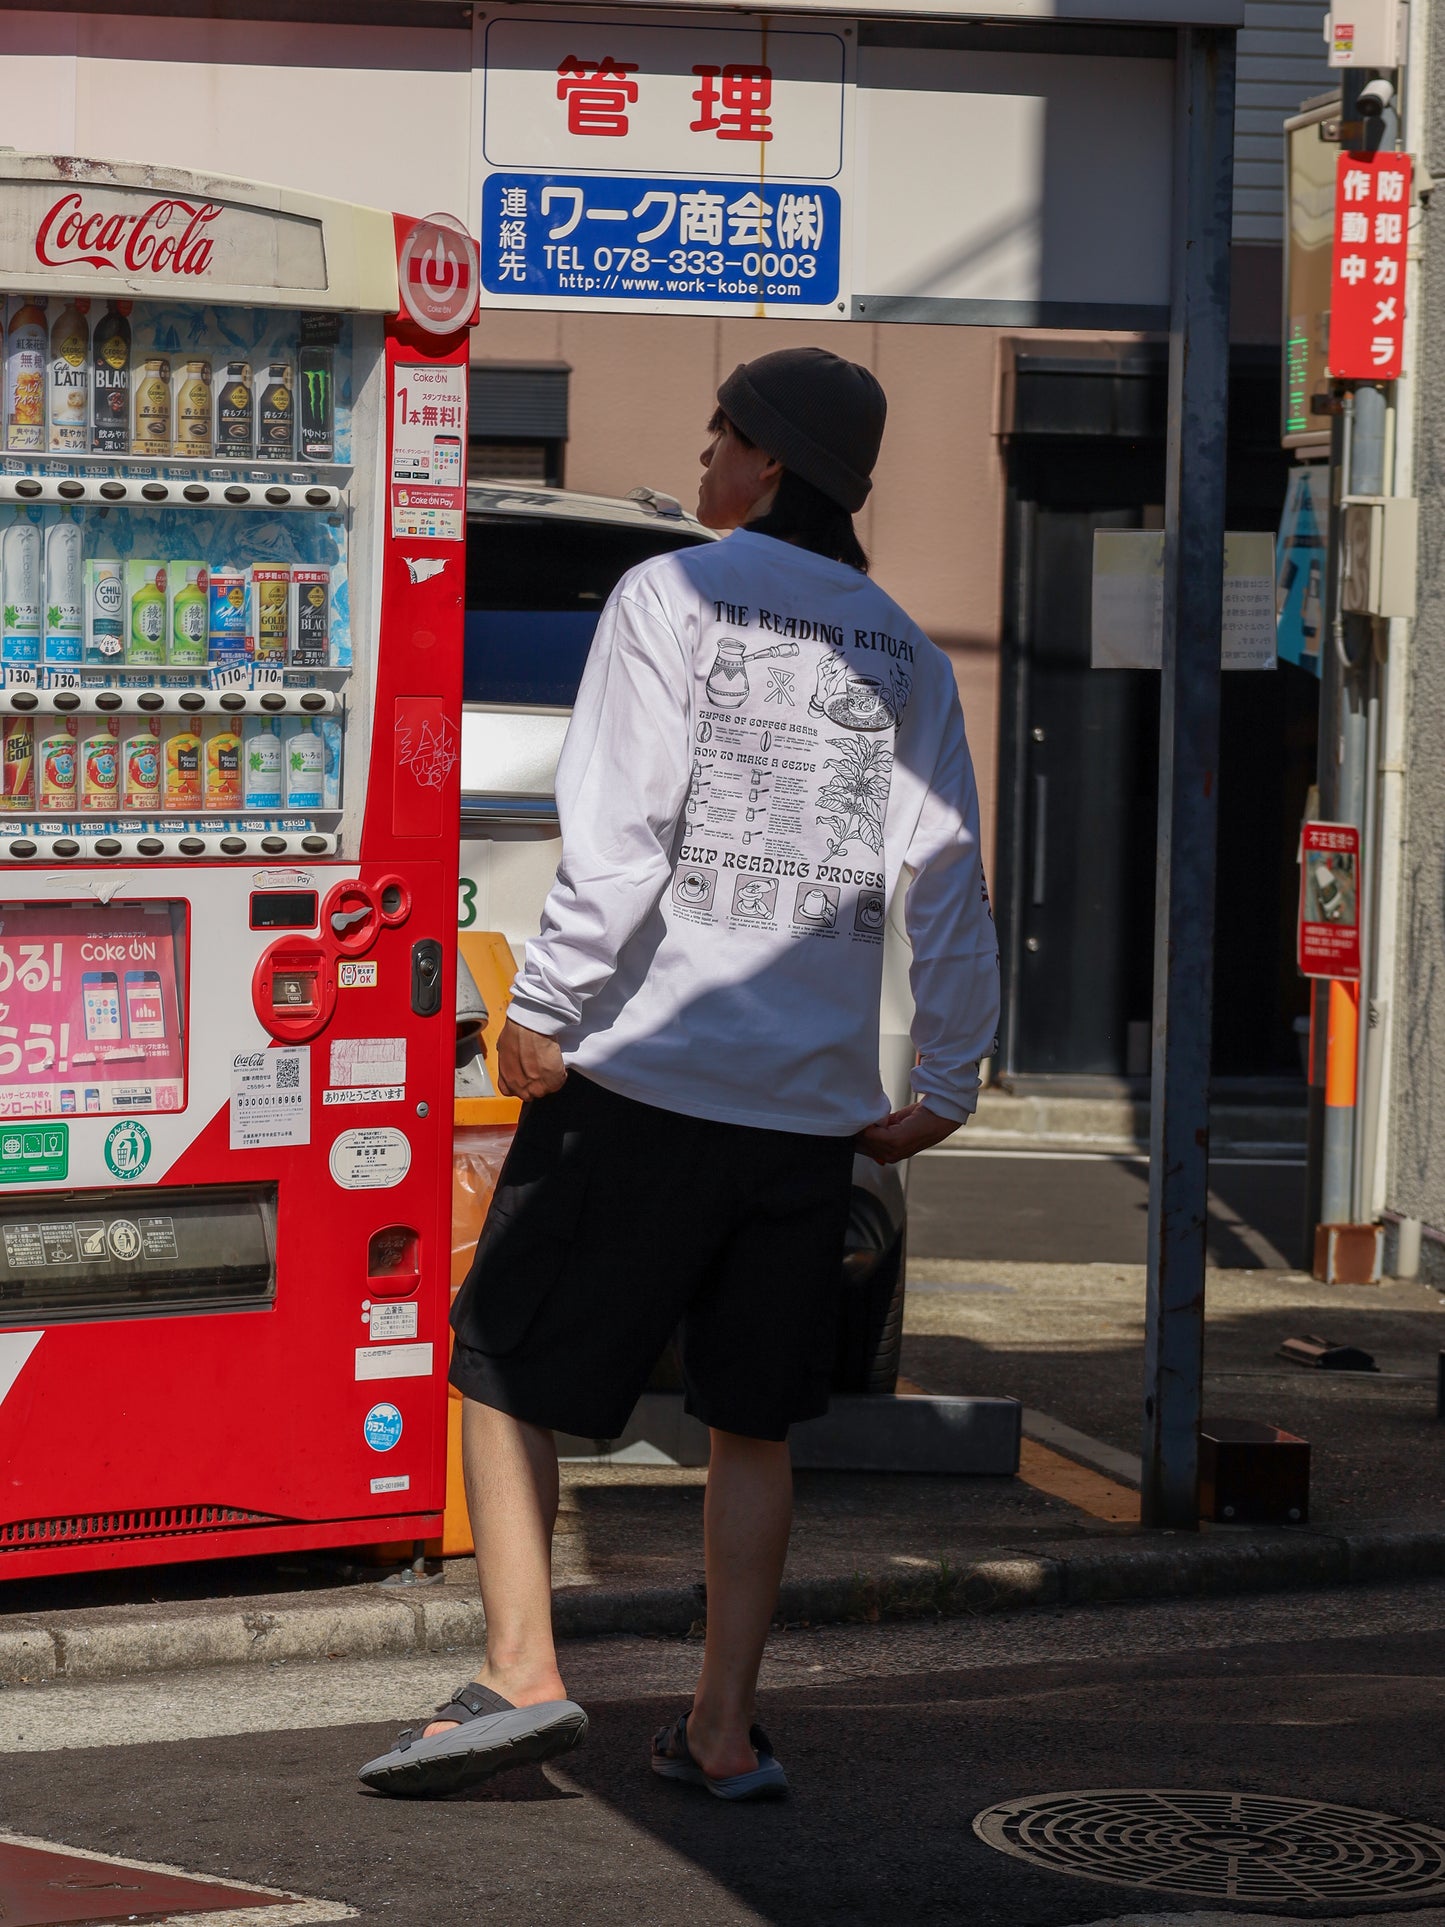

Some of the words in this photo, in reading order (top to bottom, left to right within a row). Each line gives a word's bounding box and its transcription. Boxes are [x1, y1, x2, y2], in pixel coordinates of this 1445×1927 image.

[35, 193, 224, 276] Coca-Cola
[498, 186, 528, 283] 連絡先
[1340, 169, 1371, 286] 作動中
[543, 245, 584, 271] TEL
[594, 247, 817, 279] 078-333-0003
[1370, 170, 1404, 366] 防犯カメラ
[559, 272, 801, 297] http://www.work-kobe.com
[96, 370, 127, 388] BLAC
[413, 373, 433, 383] Coke
[410, 496, 428, 504] Coke
[440, 498, 454, 508] Pay
[100, 586, 121, 595] CHILL
[103, 595, 120, 604] OUT
[301, 618, 326, 630] BLAC
[714, 601, 749, 626] THE
[758, 608, 844, 646] READING
[699, 710, 732, 723] TYPES
[734, 715, 747, 725] OF
[750, 718, 787, 731] COFFEE
[788, 723, 818, 737] BEANS
[694, 746, 718, 758] HOW
[720, 750, 733, 761] TO
[736, 752, 769, 767] MAKE
[771, 758, 779, 767] A
[781, 759, 817, 773] CEZVE
[679, 844, 718, 865] CUP
[722, 852, 810, 879] READING
[816, 864, 886, 889] PROCES
[297, 875, 310, 885] Pay
[81, 942, 126, 961] Coke
[238, 1095, 302, 1107] 9300018966
[324, 1088, 403, 1104] ありがとうございます
[108, 1120, 148, 1142] のんだあとは
[111, 1161, 147, 1180] リサイクル
